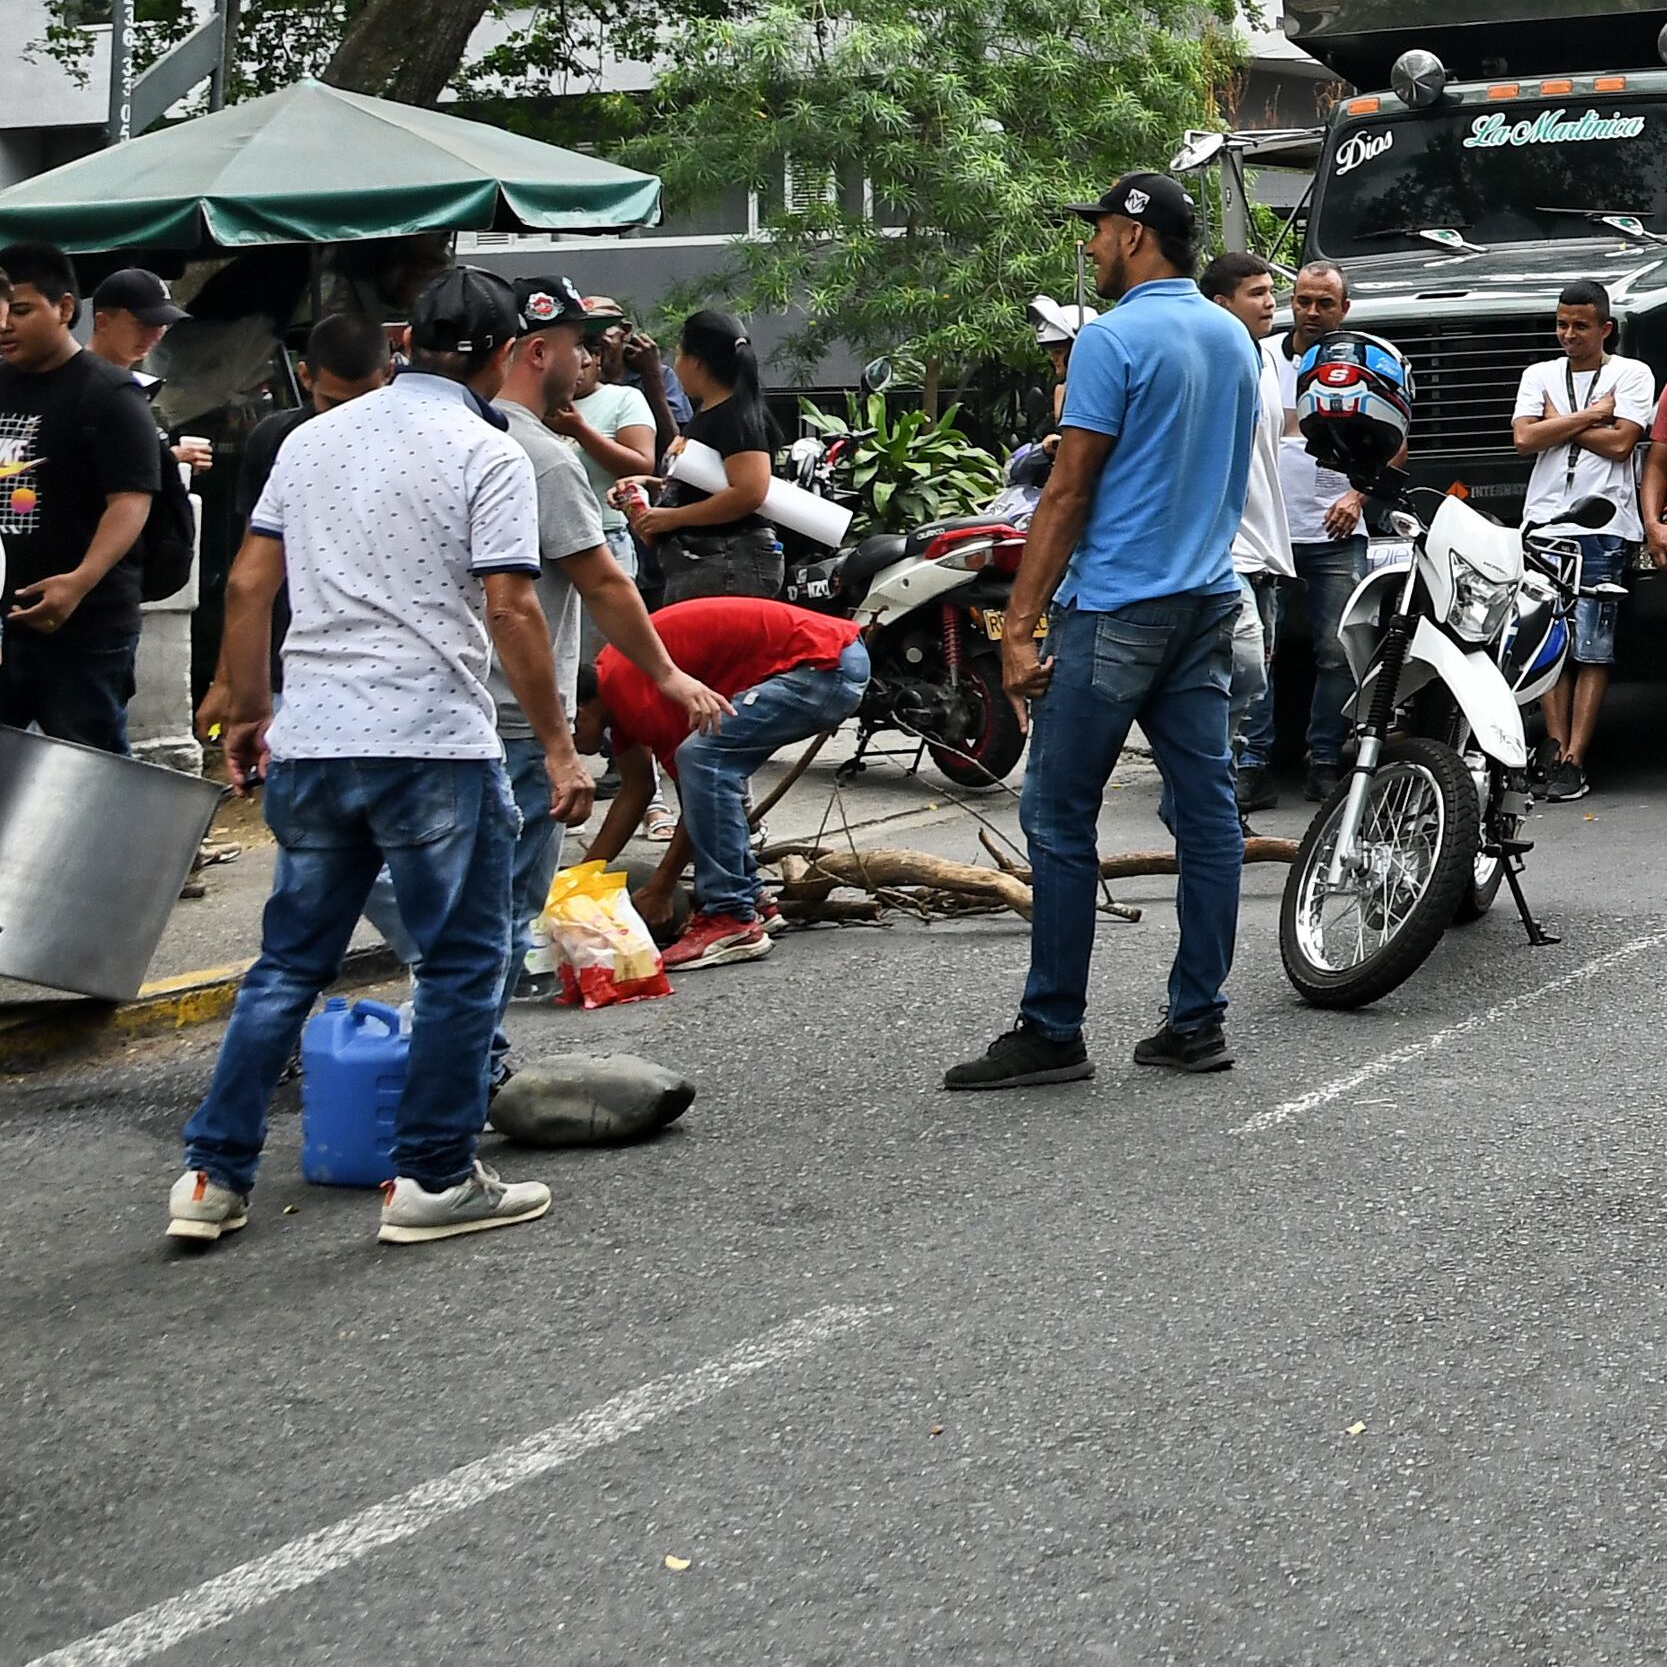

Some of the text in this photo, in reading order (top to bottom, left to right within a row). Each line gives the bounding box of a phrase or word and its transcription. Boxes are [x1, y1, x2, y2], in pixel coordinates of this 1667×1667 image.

[1462, 108, 1646, 148] La Martinica
[1335, 129, 1394, 176] Dios
